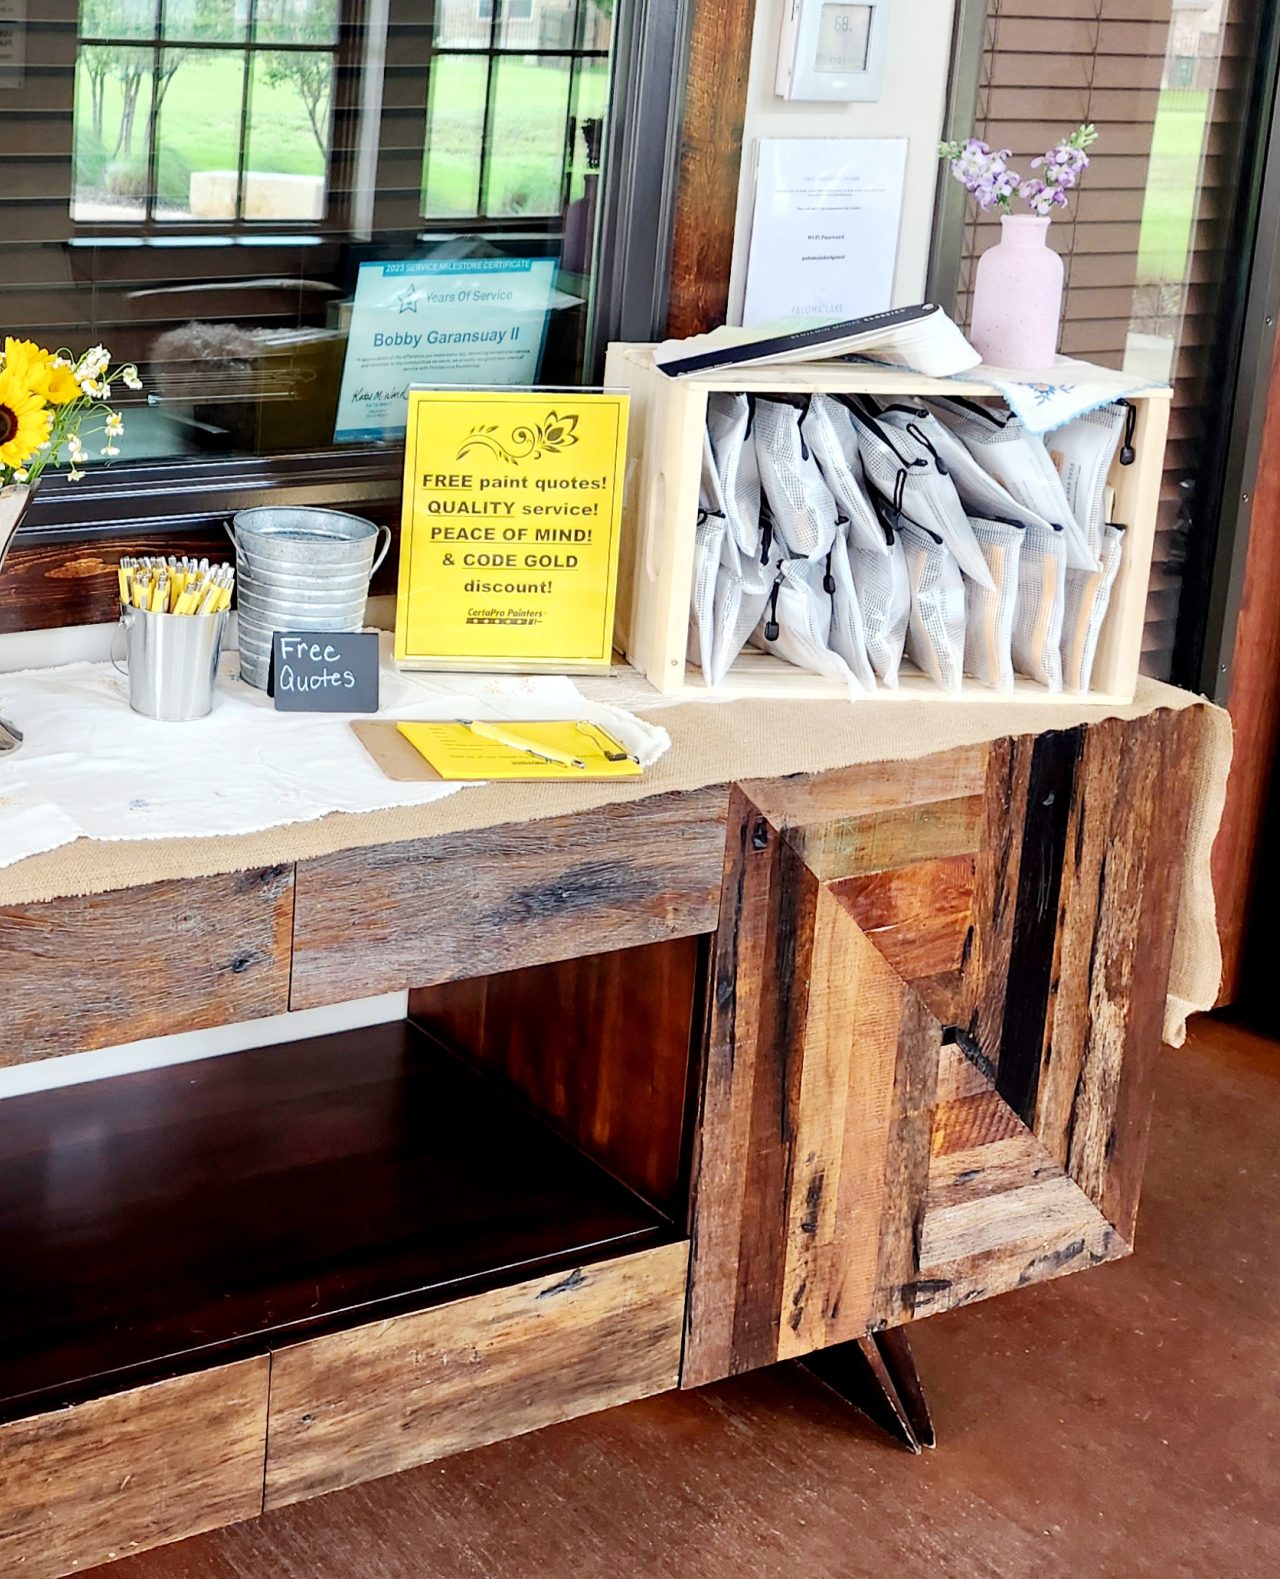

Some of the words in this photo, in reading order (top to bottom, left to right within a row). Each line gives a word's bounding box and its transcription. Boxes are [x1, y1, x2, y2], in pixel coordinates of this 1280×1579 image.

[405, 262, 439, 272] SERVICE
[439, 261, 481, 271] MILESTONE
[483, 260, 531, 270] CERTIFICATE
[425, 292, 456, 303] Years
[457, 291, 472, 302] Of
[473, 289, 513, 301] Service
[373, 332, 422, 349] Bobby
[427, 329, 507, 345] Garansuay
[510, 326, 520, 341] II
[422, 474, 473, 488] FREE
[479, 475, 528, 491] paint
[535, 476, 607, 492] quotes!
[427, 500, 516, 515] QUALITY
[521, 503, 599, 516] service!
[430, 527, 496, 541] PEACE
[502, 528, 528, 541] OF
[535, 528, 592, 542] MIND!
[442, 553, 455, 566] &
[463, 553, 518, 567] CODE
[524, 555, 578, 568] GOLD
[464, 580, 553, 594] discount!
[467, 608, 505, 617] CertaPro
[507, 608, 543, 617] Painters
[279, 637, 341, 662] Free
[279, 664, 356, 691] Quotes
